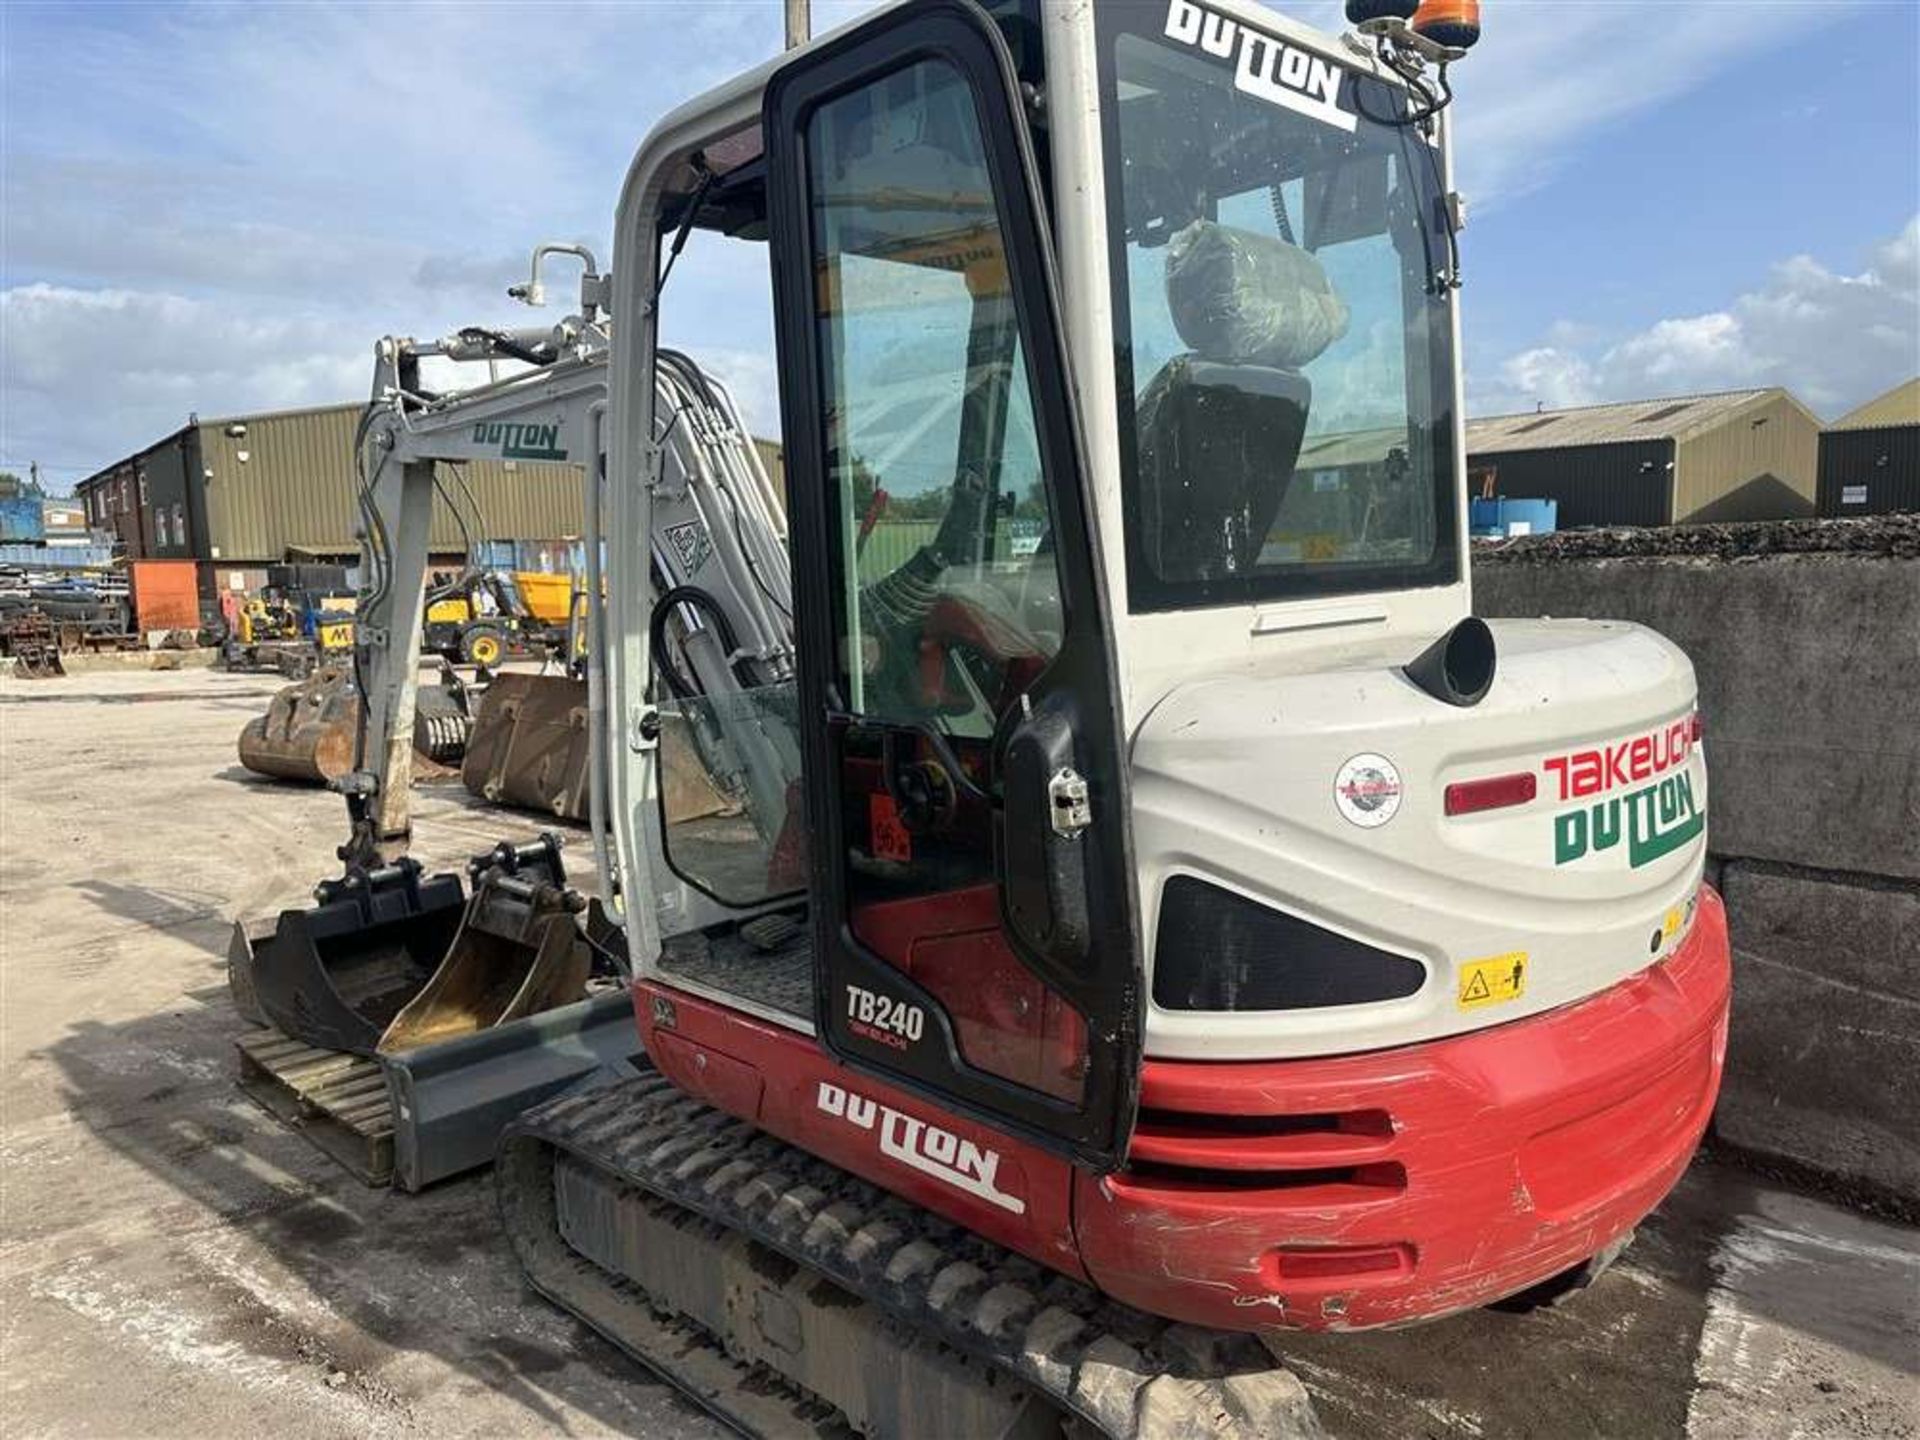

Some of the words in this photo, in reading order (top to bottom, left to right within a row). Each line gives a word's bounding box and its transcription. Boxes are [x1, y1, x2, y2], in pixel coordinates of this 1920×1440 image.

[1164, 0, 1358, 132] DUTTON
[473, 423, 568, 461] DUTTON
[1543, 721, 1698, 801] TAKEUCH
[1554, 769, 1705, 870] DUTTON
[846, 983, 925, 1042] TB240
[817, 1081, 1027, 1216] DUTTON
